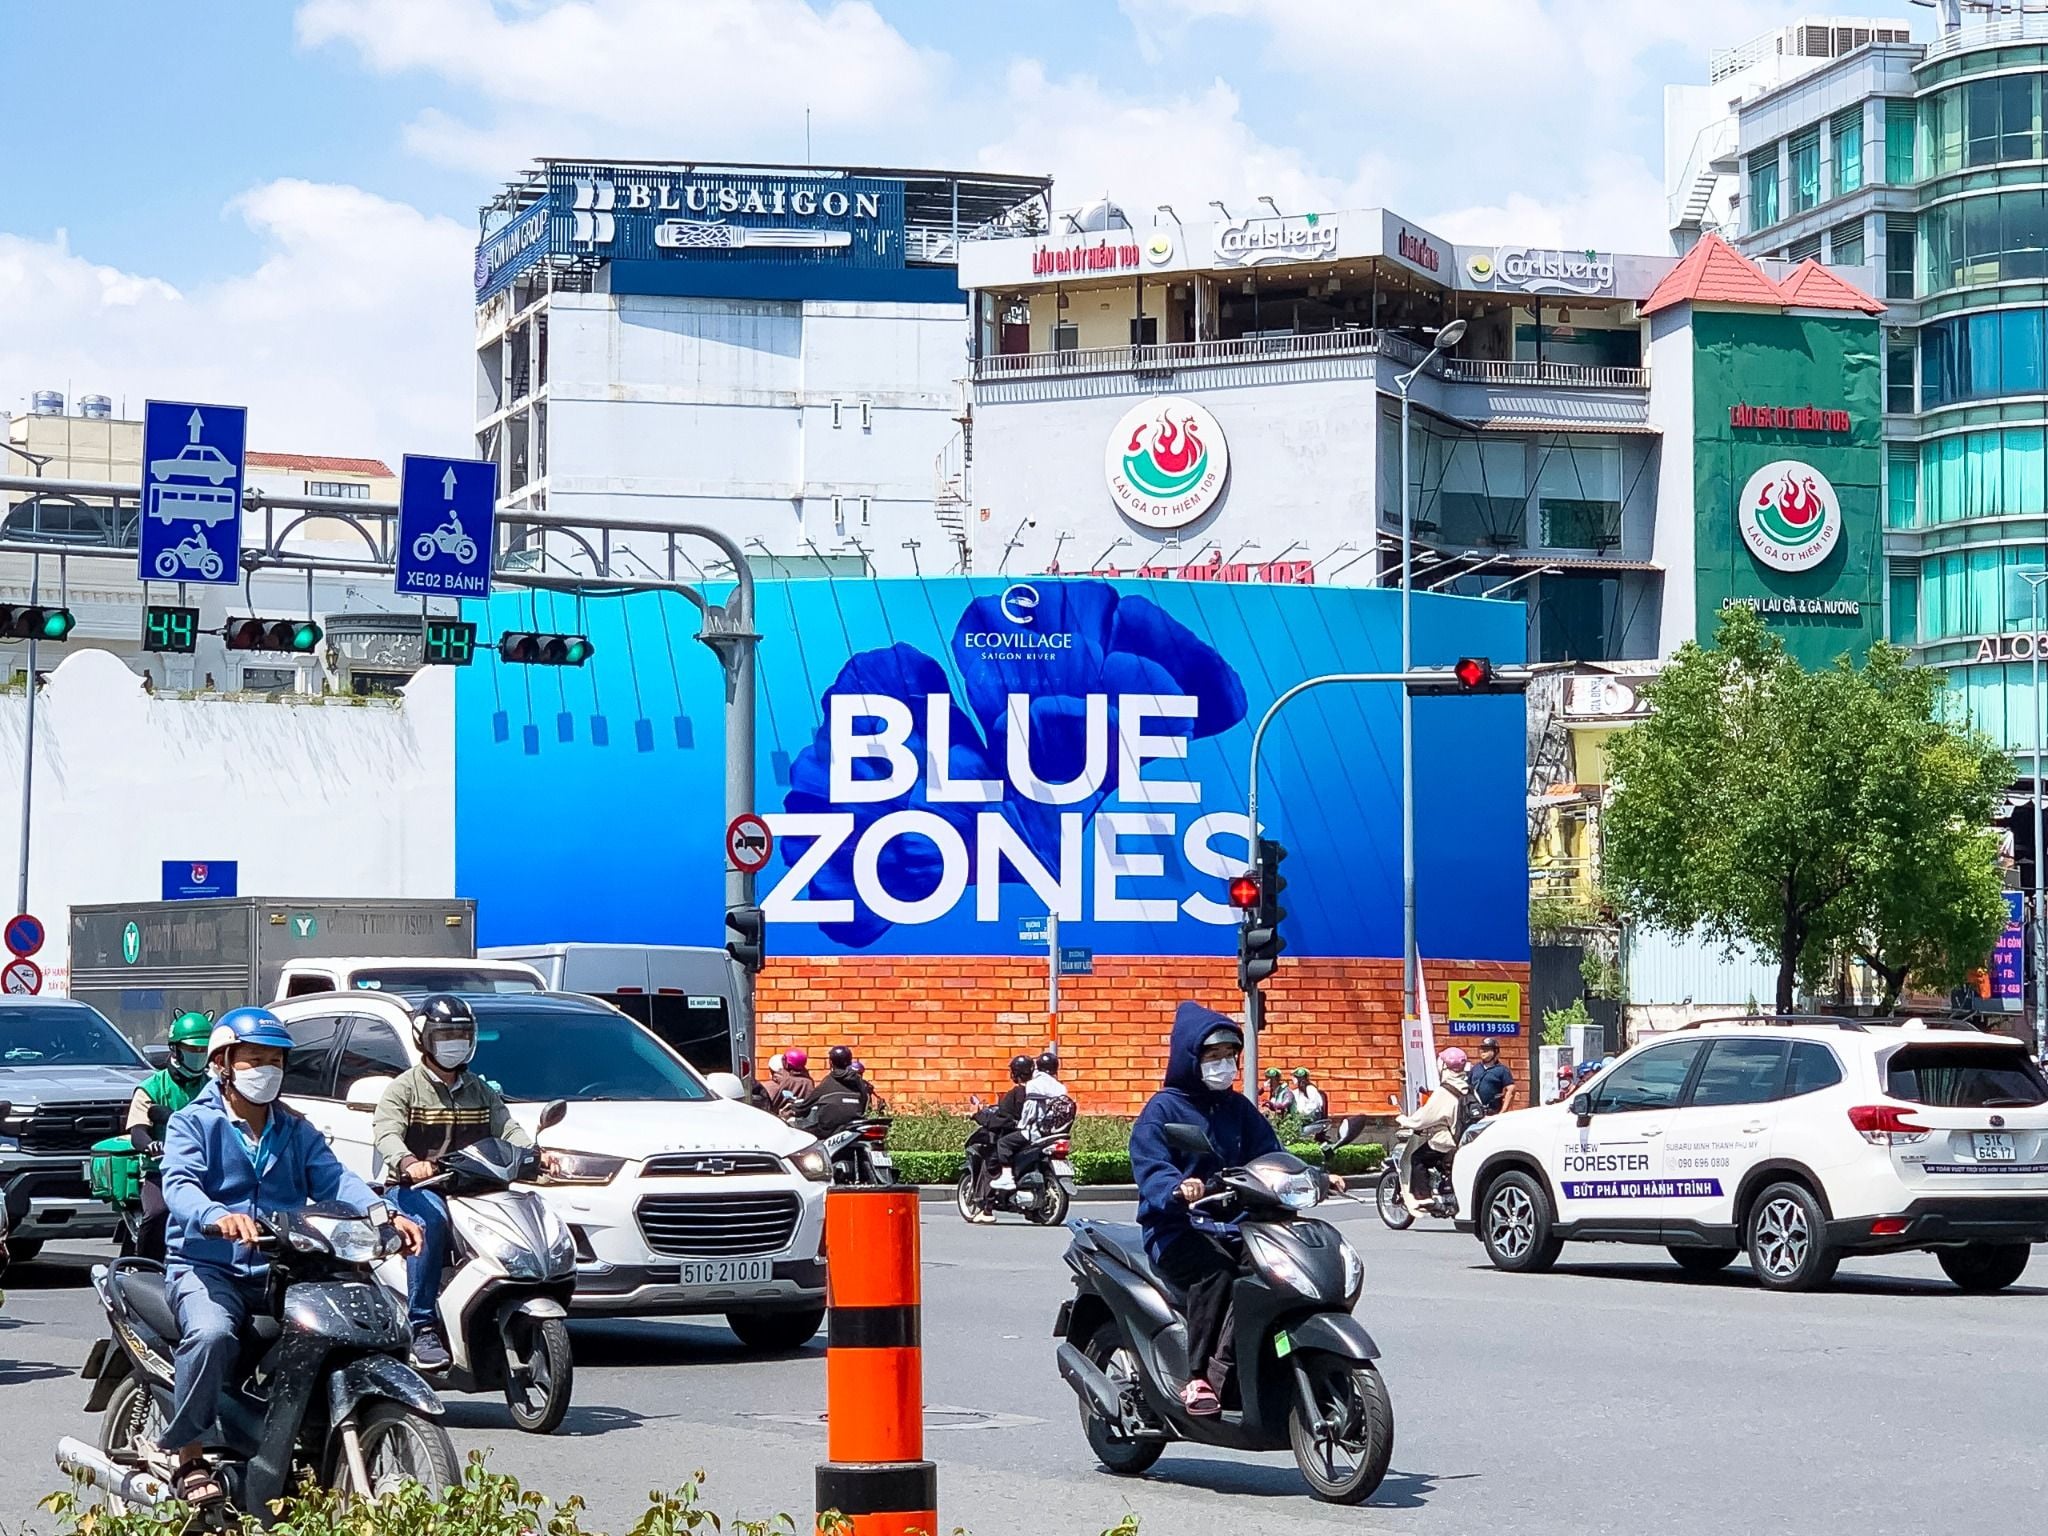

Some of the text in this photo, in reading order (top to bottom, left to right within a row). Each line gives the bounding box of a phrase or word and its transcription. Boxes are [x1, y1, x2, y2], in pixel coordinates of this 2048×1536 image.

[629, 184, 880, 218] BLUSAIGON
[1214, 220, 1338, 261] Carlsberg
[1495, 246, 1614, 288] Carlsberg
[1201, 472, 1216, 493] 109
[1821, 524, 1834, 542] 109
[444, 572, 485, 591] BÁNH
[148, 613, 191, 647] 44
[428, 627, 469, 660] 44
[965, 632, 1073, 649] ECOVILLAGE
[981, 651, 1056, 661] SAIGON RIVER
[829, 693, 1201, 804] BLUE
[759, 808, 1267, 925] ZONES
[1466, 1022, 1485, 1032] 0911
[1486, 1023, 1496, 1033] 39
[1497, 1023, 1516, 1034] 5555
[1565, 1143, 1599, 1153] THE NEW
[1984, 1134, 2003, 1146] 51K
[1564, 1154, 1650, 1172] FORESTER
[1643, 1179, 1674, 1197] HÀNH
[1676, 1178, 1712, 1196] TRÌNH
